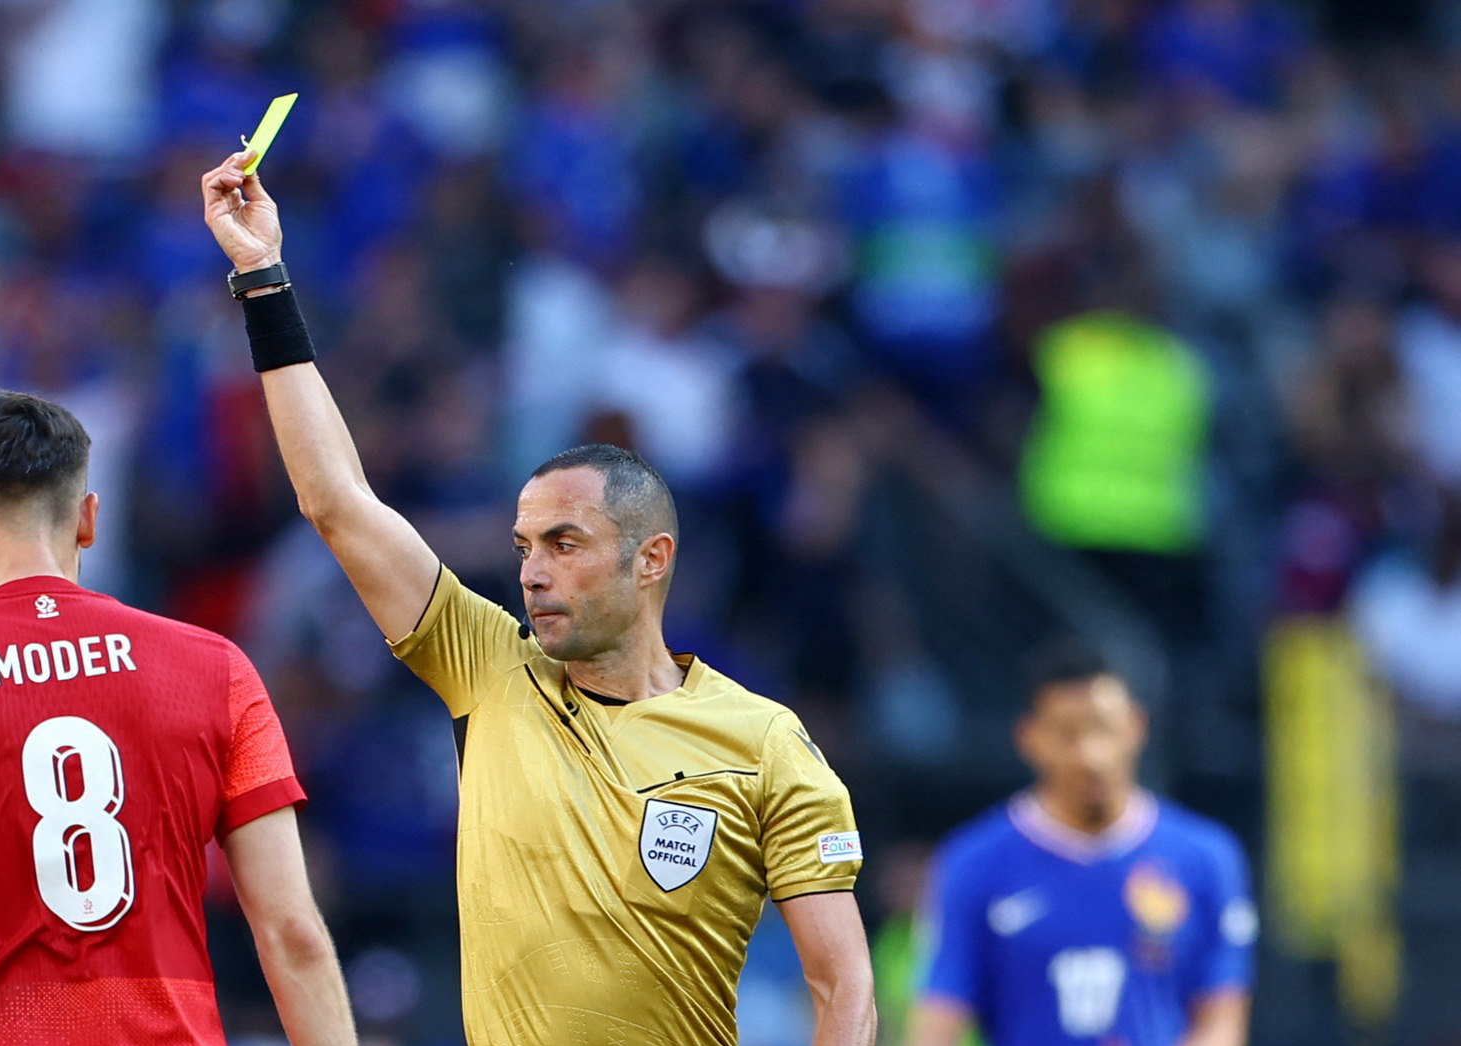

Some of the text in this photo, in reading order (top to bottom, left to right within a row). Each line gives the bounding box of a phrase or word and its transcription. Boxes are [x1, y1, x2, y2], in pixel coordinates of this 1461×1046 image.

[22, 716, 135, 932] 8
[658, 813, 700, 834] UEFA
[655, 838, 696, 854] MATCH
[648, 849, 698, 868] OFFICIAL
